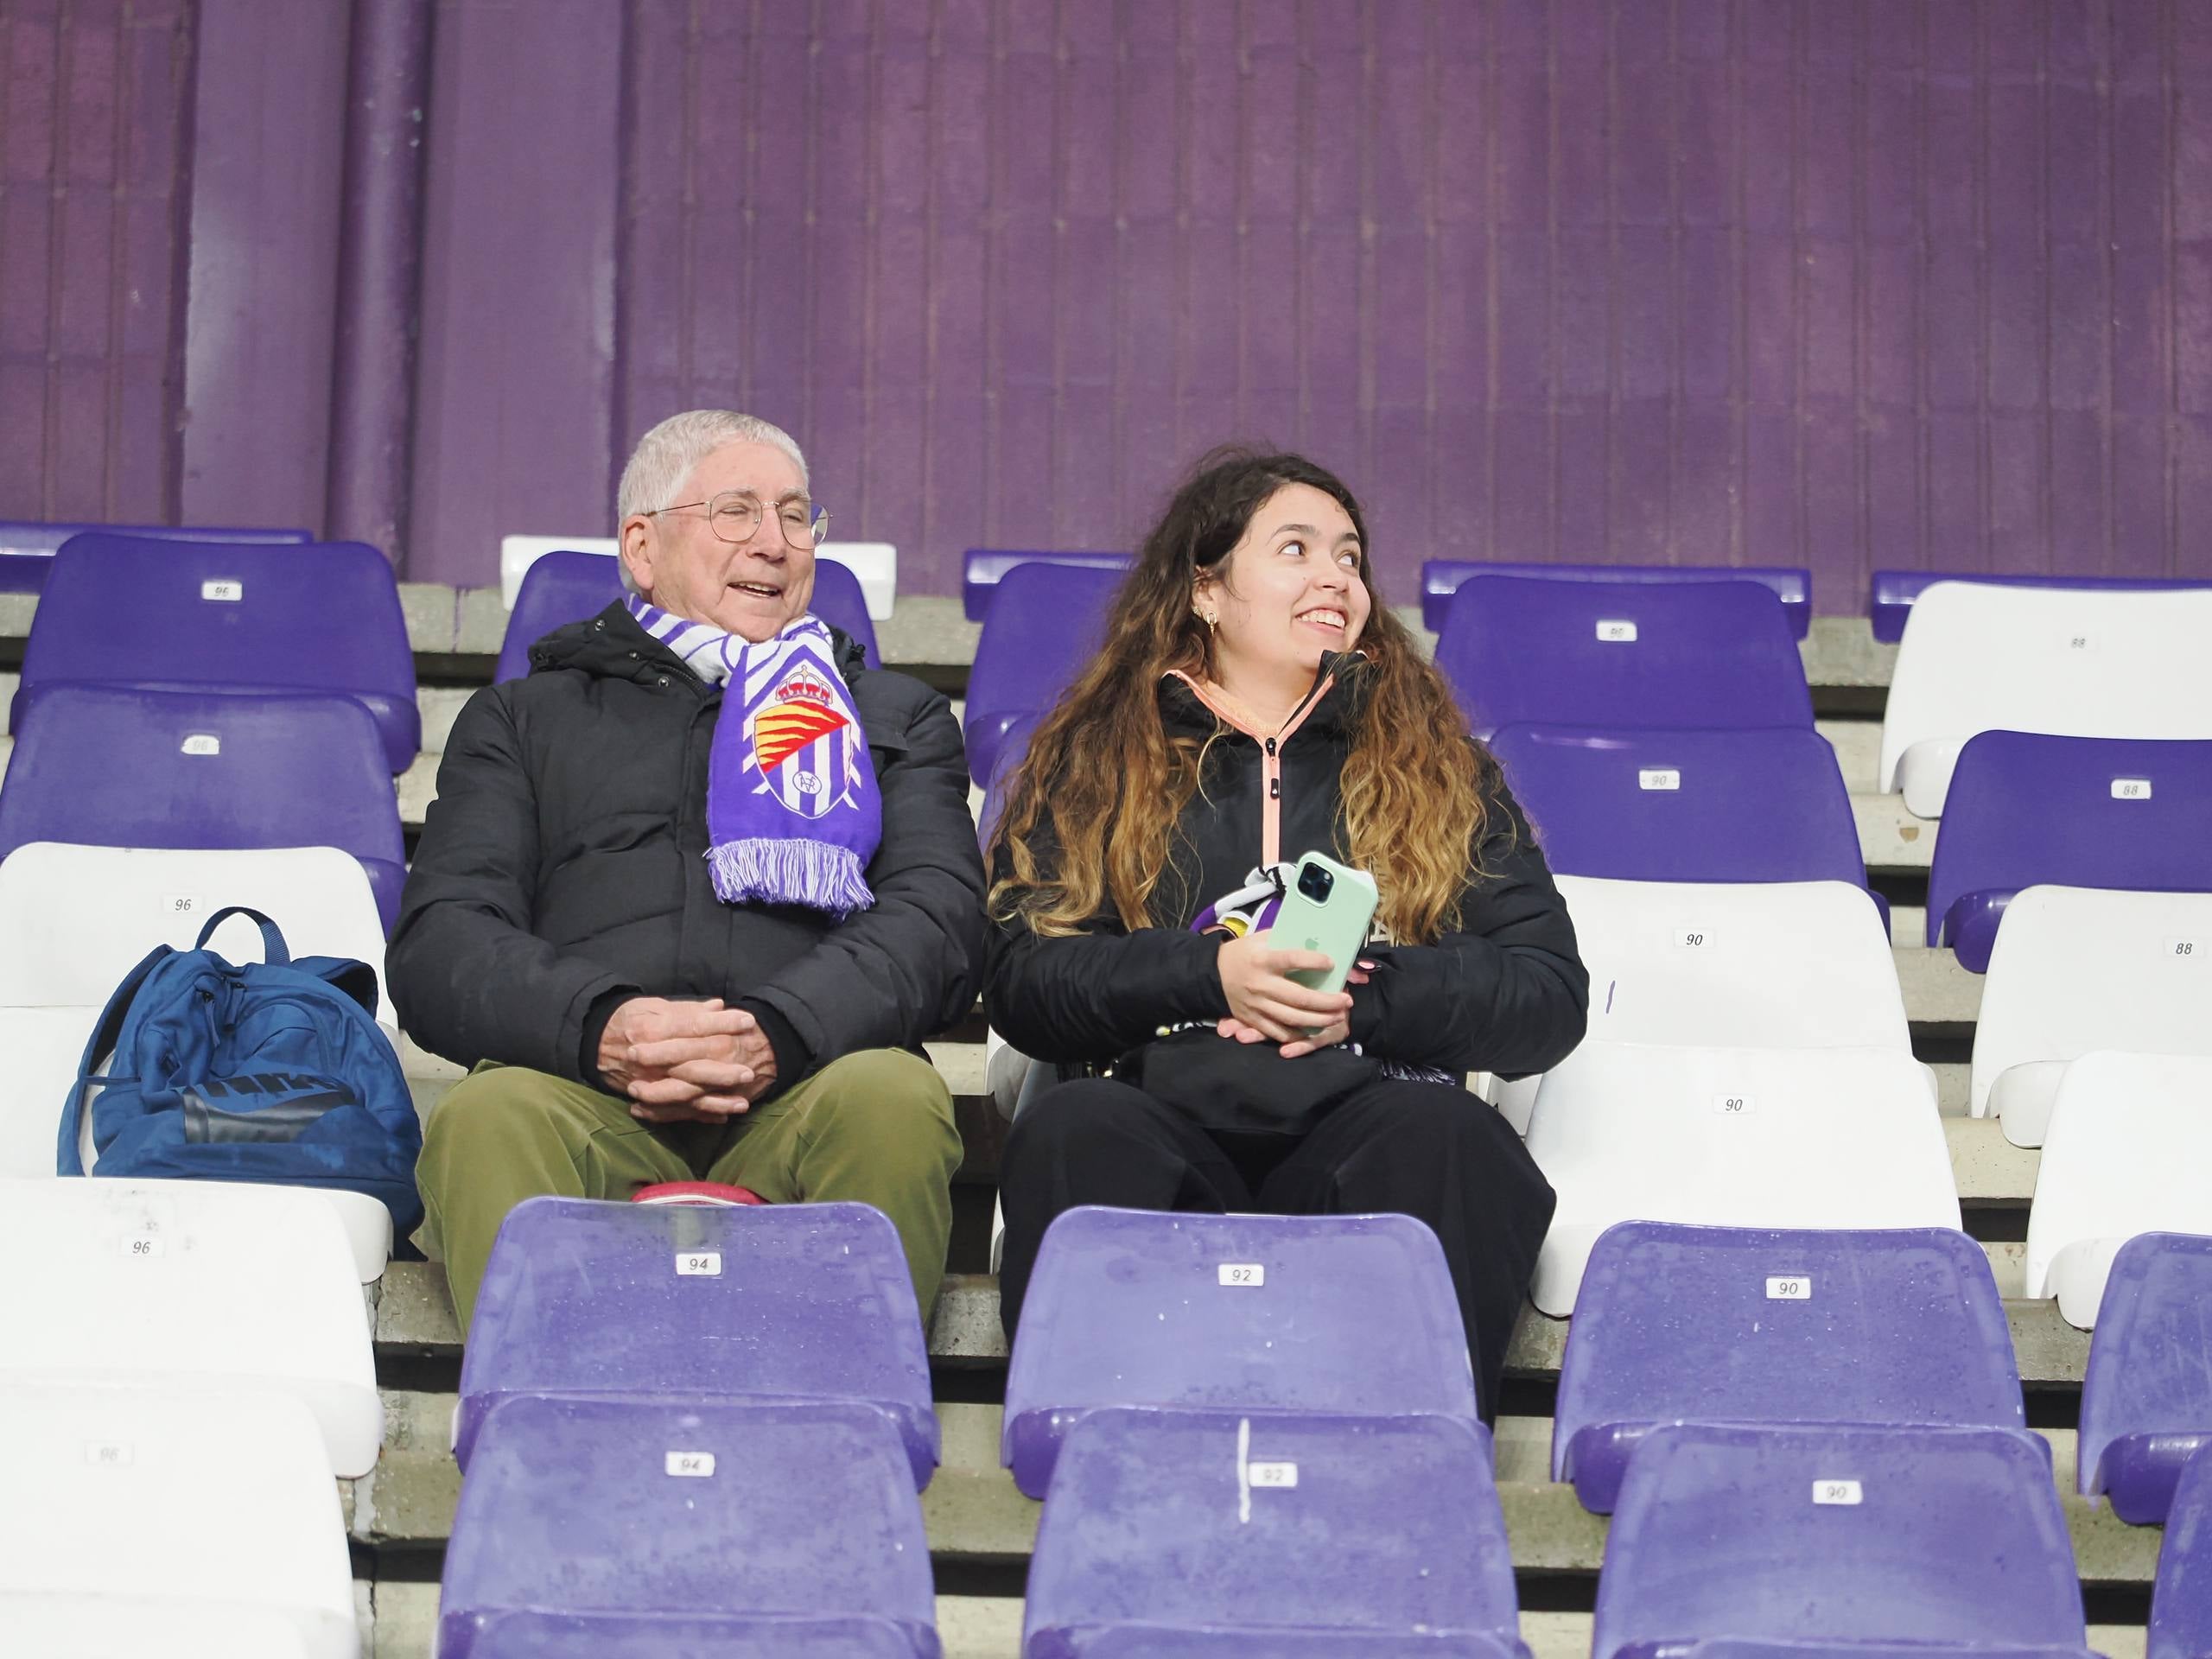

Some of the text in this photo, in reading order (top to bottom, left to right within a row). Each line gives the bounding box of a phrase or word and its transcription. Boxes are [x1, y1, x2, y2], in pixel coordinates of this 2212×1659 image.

[1652, 775, 1667, 786] 90
[2123, 785, 2139, 796] 88
[175, 899, 192, 911] 96
[1686, 934, 1703, 946] 90
[2176, 943, 2192, 955] 88
[1726, 1098, 1743, 1111] 90
[132, 1241, 151, 1254] 96
[690, 1258, 709, 1270] 94
[1232, 1269, 1252, 1281] 92
[1779, 1282, 1798, 1294] 90
[1827, 1486, 1847, 1499] 90
